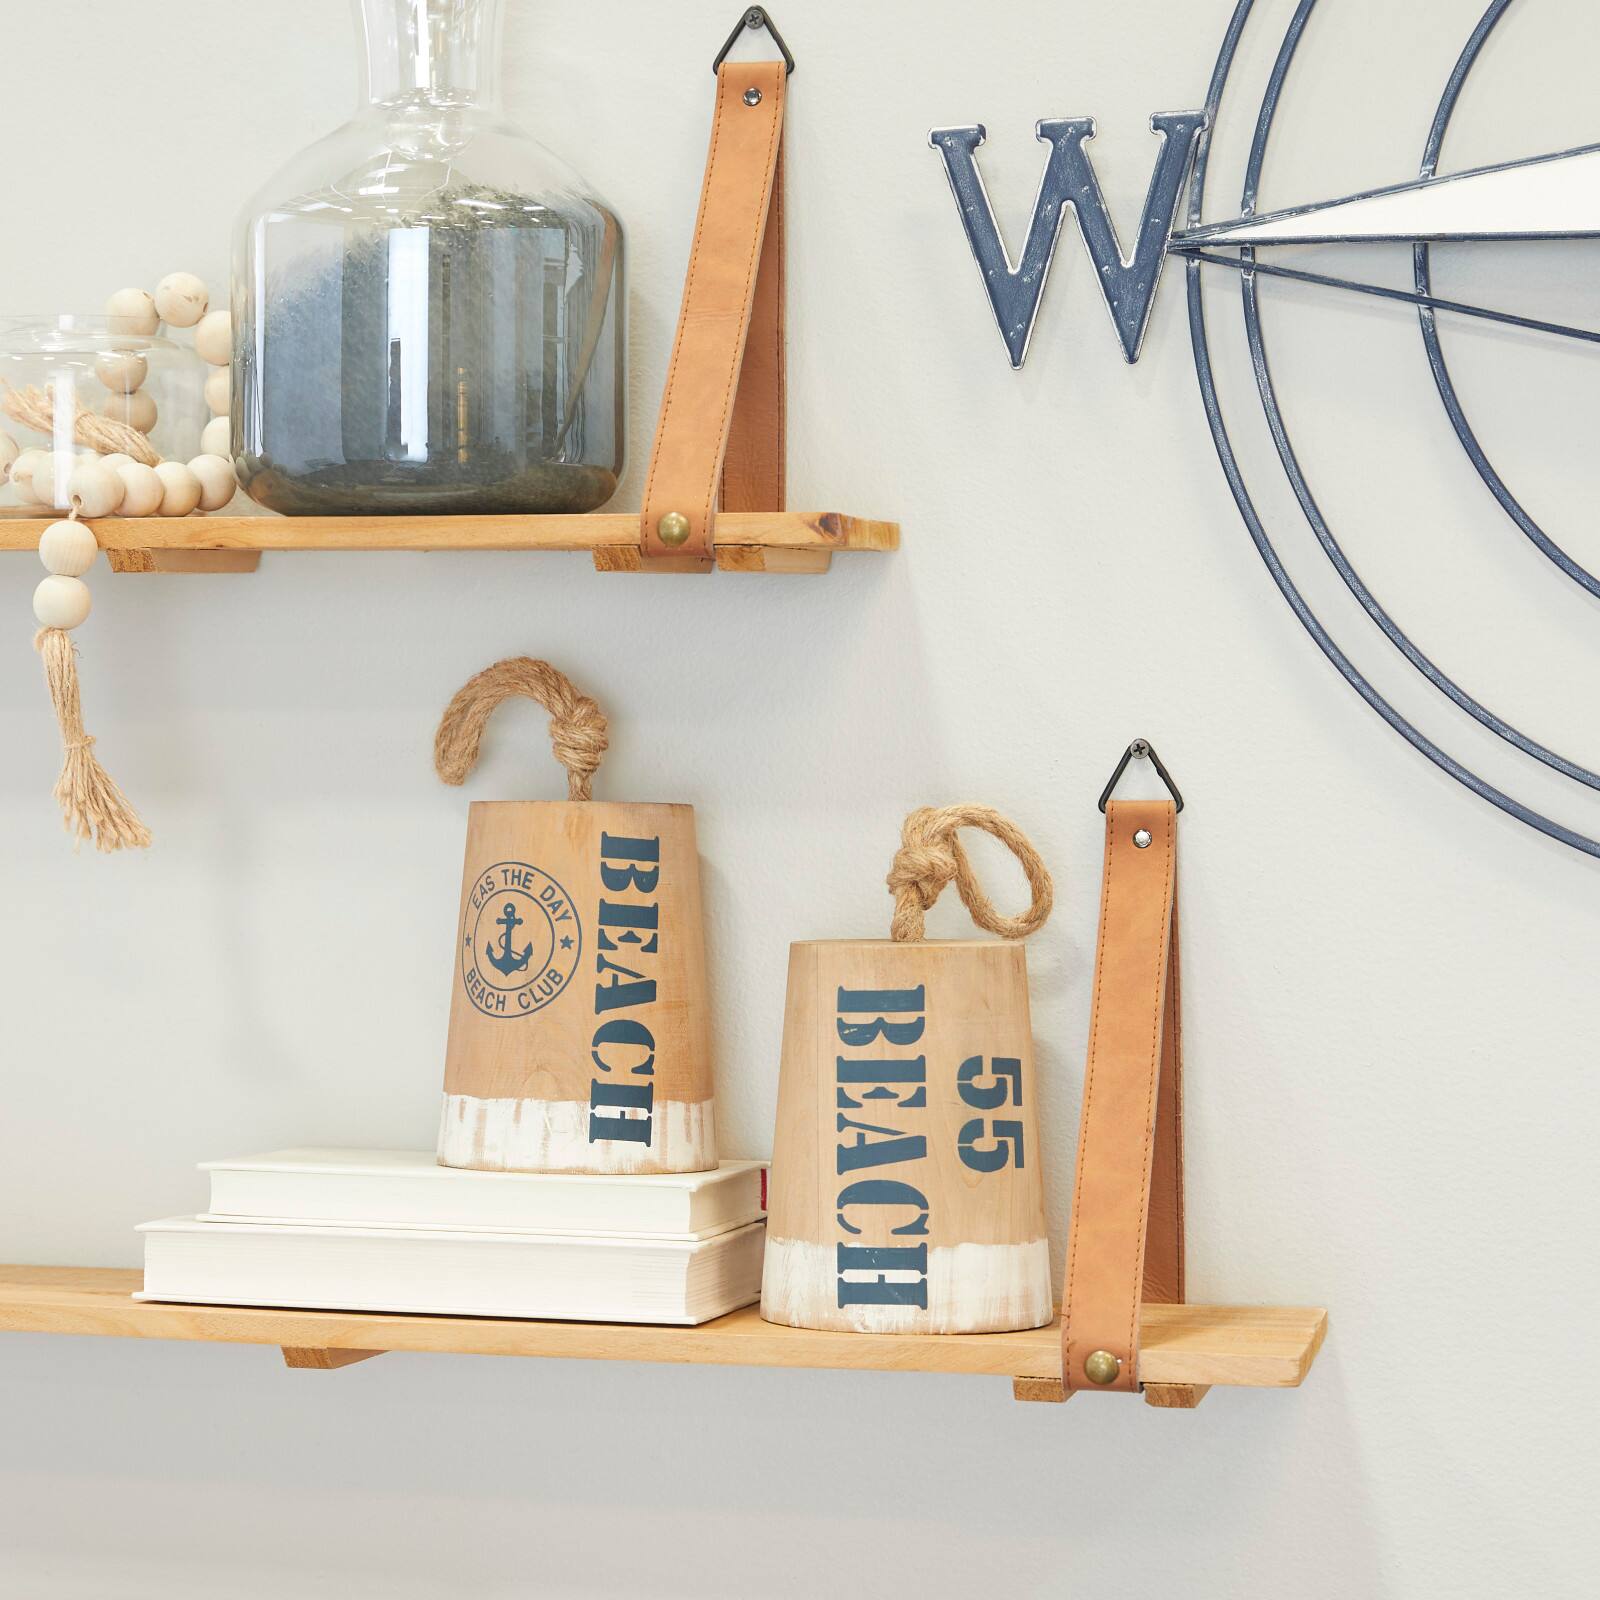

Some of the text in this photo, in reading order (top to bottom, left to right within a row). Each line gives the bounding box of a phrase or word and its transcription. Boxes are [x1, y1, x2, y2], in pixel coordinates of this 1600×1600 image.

[928, 109, 1209, 370] W
[466, 967, 564, 1012] BEACH CLUB
[472, 868, 573, 922] EAS THE DAY
[589, 831, 660, 1148] BEACH
[836, 984, 930, 1311] BEACH
[956, 1054, 1025, 1173] 55
